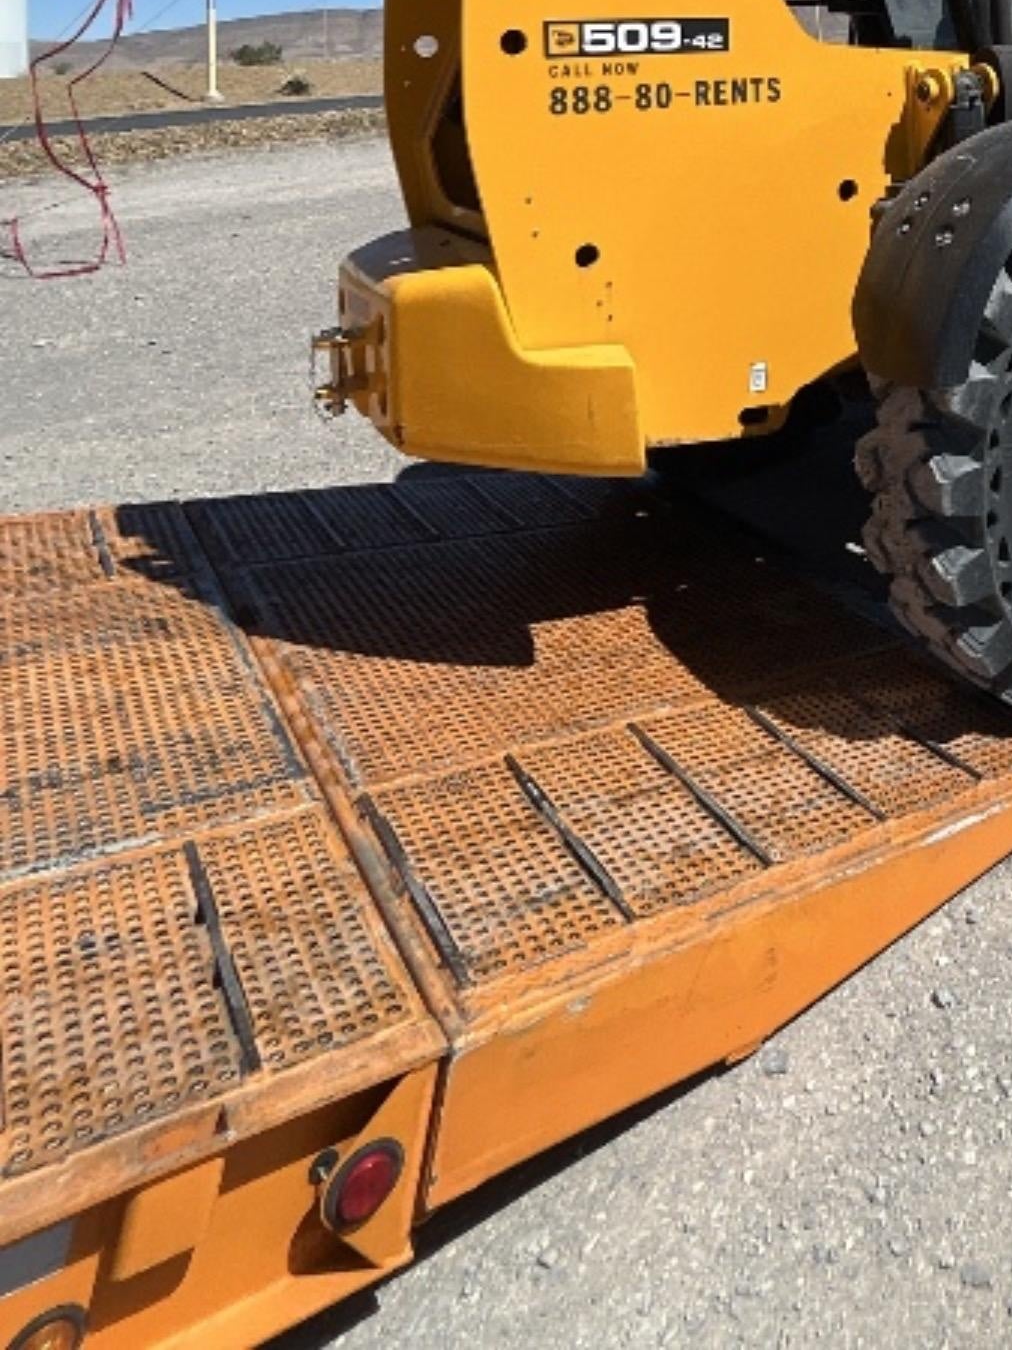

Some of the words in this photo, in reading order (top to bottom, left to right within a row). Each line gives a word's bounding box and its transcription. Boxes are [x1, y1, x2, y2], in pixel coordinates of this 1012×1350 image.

[549, 64, 592, 78] CALL
[602, 62, 640, 75] NOW
[550, 77, 781, 115] 888-80-RENTS
